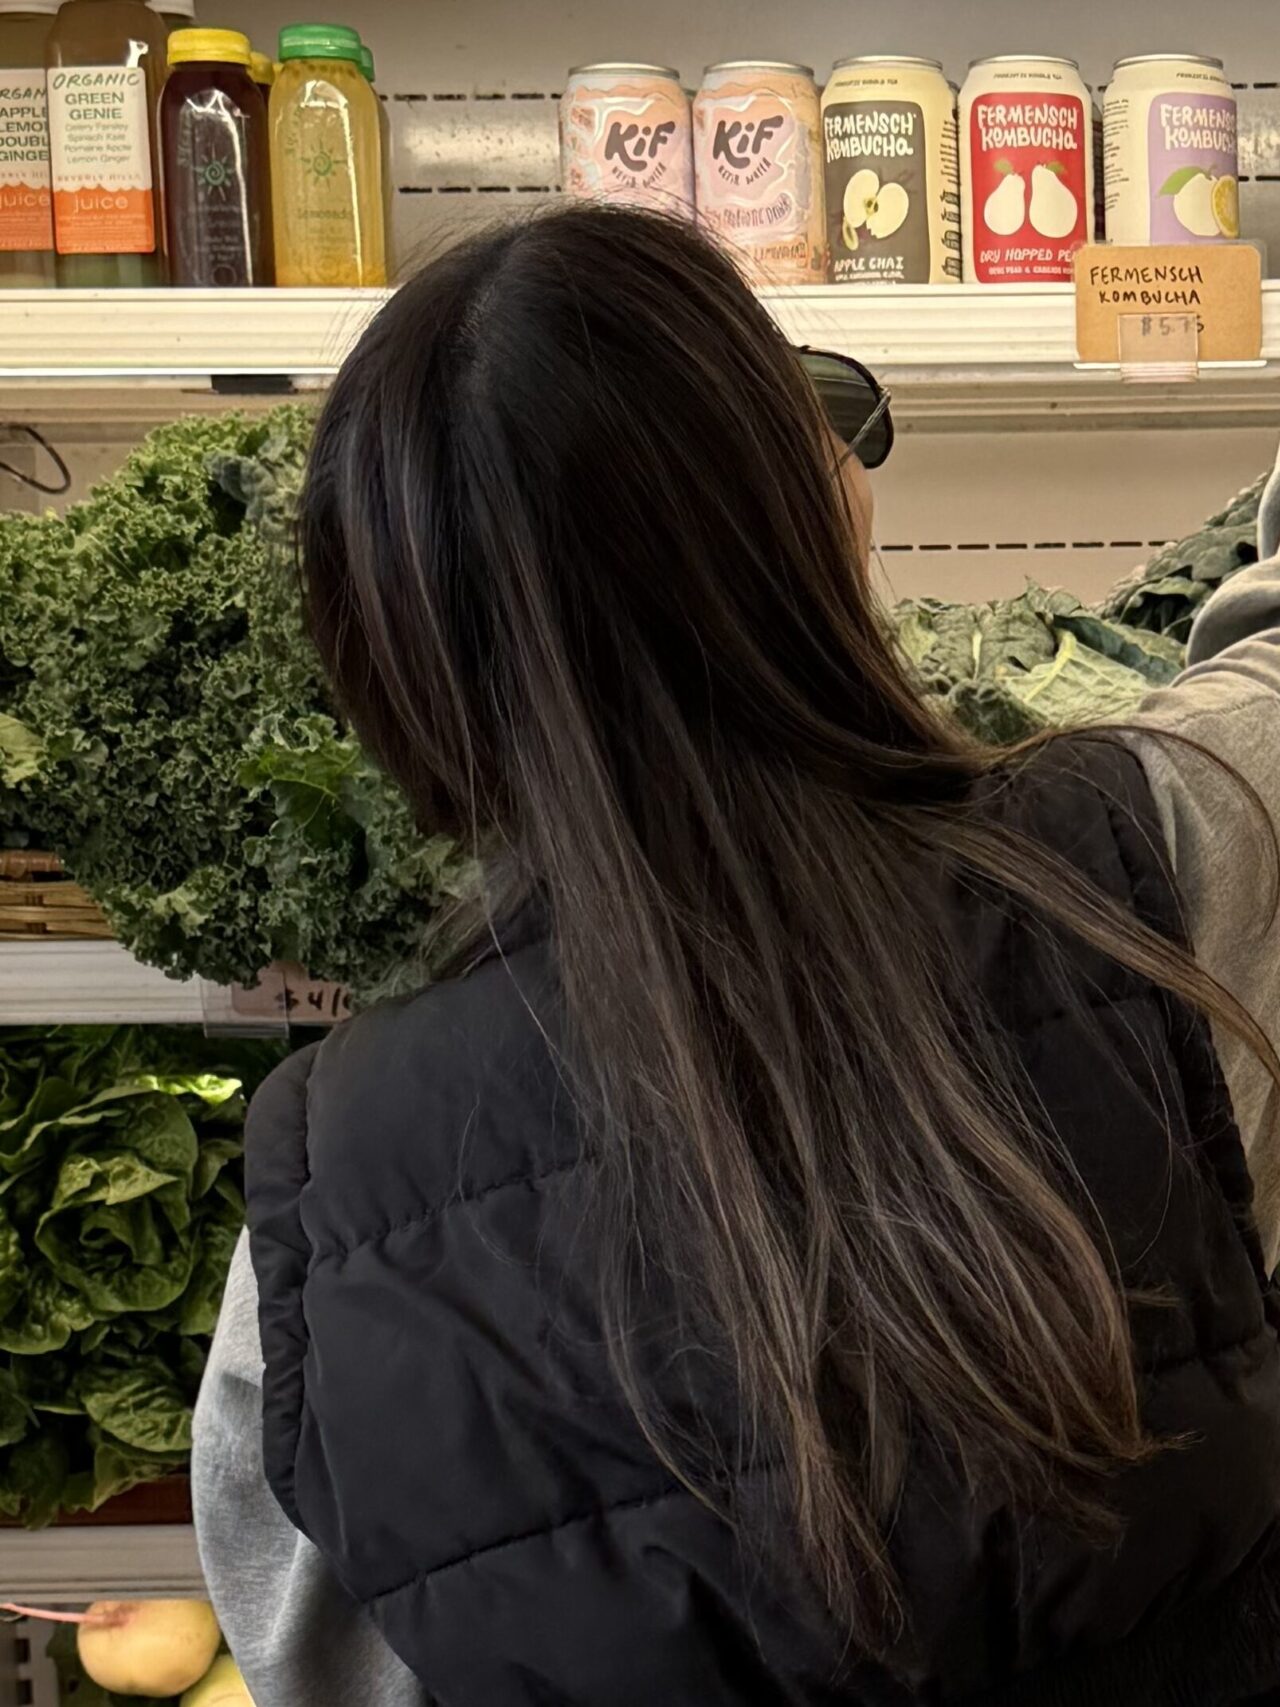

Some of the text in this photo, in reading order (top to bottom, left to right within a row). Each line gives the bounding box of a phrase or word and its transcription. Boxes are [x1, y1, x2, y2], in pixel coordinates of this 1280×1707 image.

[52, 72, 140, 90] ORGANIC
[0, 88, 47, 100] RGAN
[64, 92, 125, 106] GREEN
[69, 107, 123, 121] GENIE
[977, 103, 1078, 130] FERMENSCH
[824, 112, 913, 136] FERMENSCH
[0, 135, 49, 148] OUBL
[0, 149, 50, 162] GINGE
[2, 192, 51, 207] uice
[74, 195, 129, 212] juice
[980, 247, 1075, 264] DRY HOPPED PE
[869, 256, 904, 271] CHAI
[1090, 266, 1203, 285] FERMENSCH
[1099, 290, 1201, 305] KOMBUCHA
